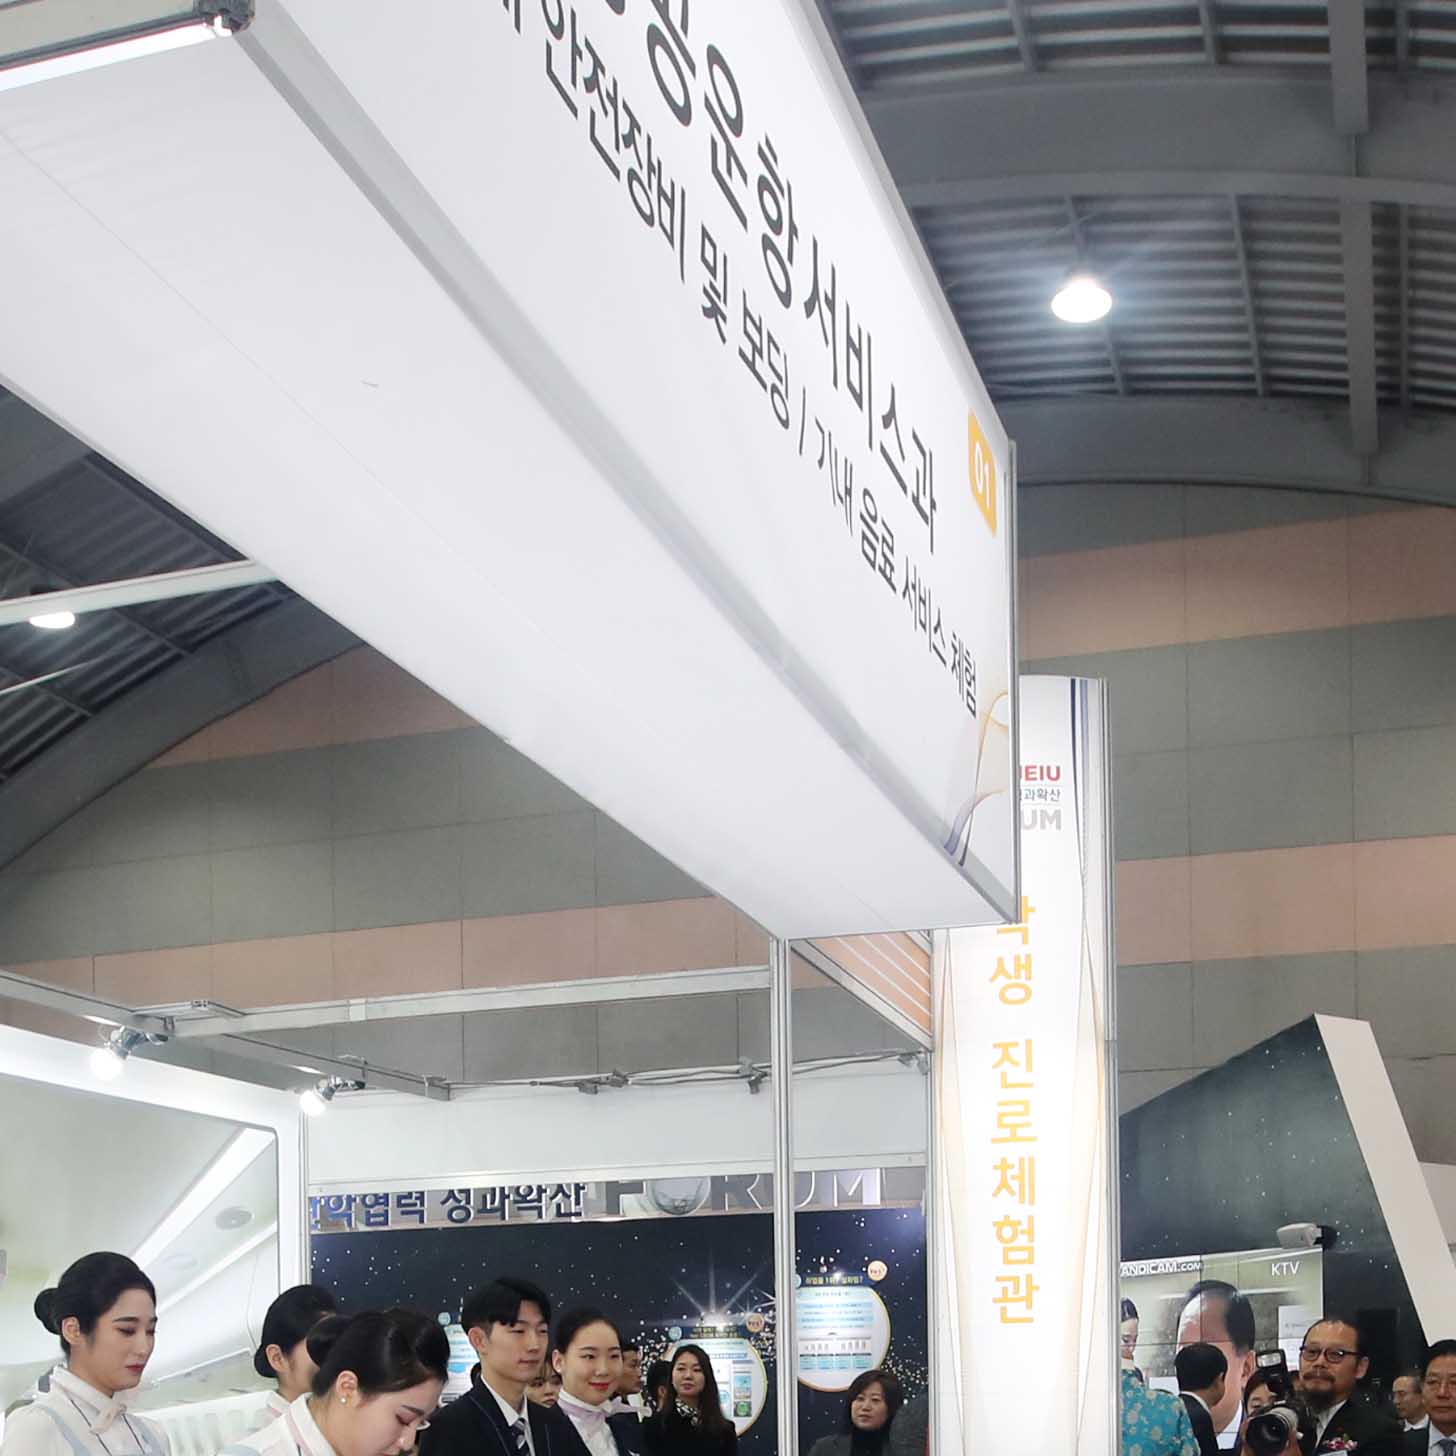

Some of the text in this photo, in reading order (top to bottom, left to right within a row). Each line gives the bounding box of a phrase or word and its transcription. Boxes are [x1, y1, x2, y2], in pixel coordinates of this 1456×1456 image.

[605, 0, 937, 555] 공운항서비스과
[700, 221, 729, 345] 및
[739, 288, 789, 430] 보딩
[815, 415, 854, 537] 기내
[859, 488, 897, 595] 음료
[902, 555, 947, 668] 서비스
[951, 630, 978, 720] 체험
[974, 441, 994, 511] 01
[1020, 765, 1061, 782] EIU
[1020, 788, 1061, 802] 과확산
[990, 1037, 1040, 1325] 진로체험관
[1271, 1261, 1301, 1277] KTV
